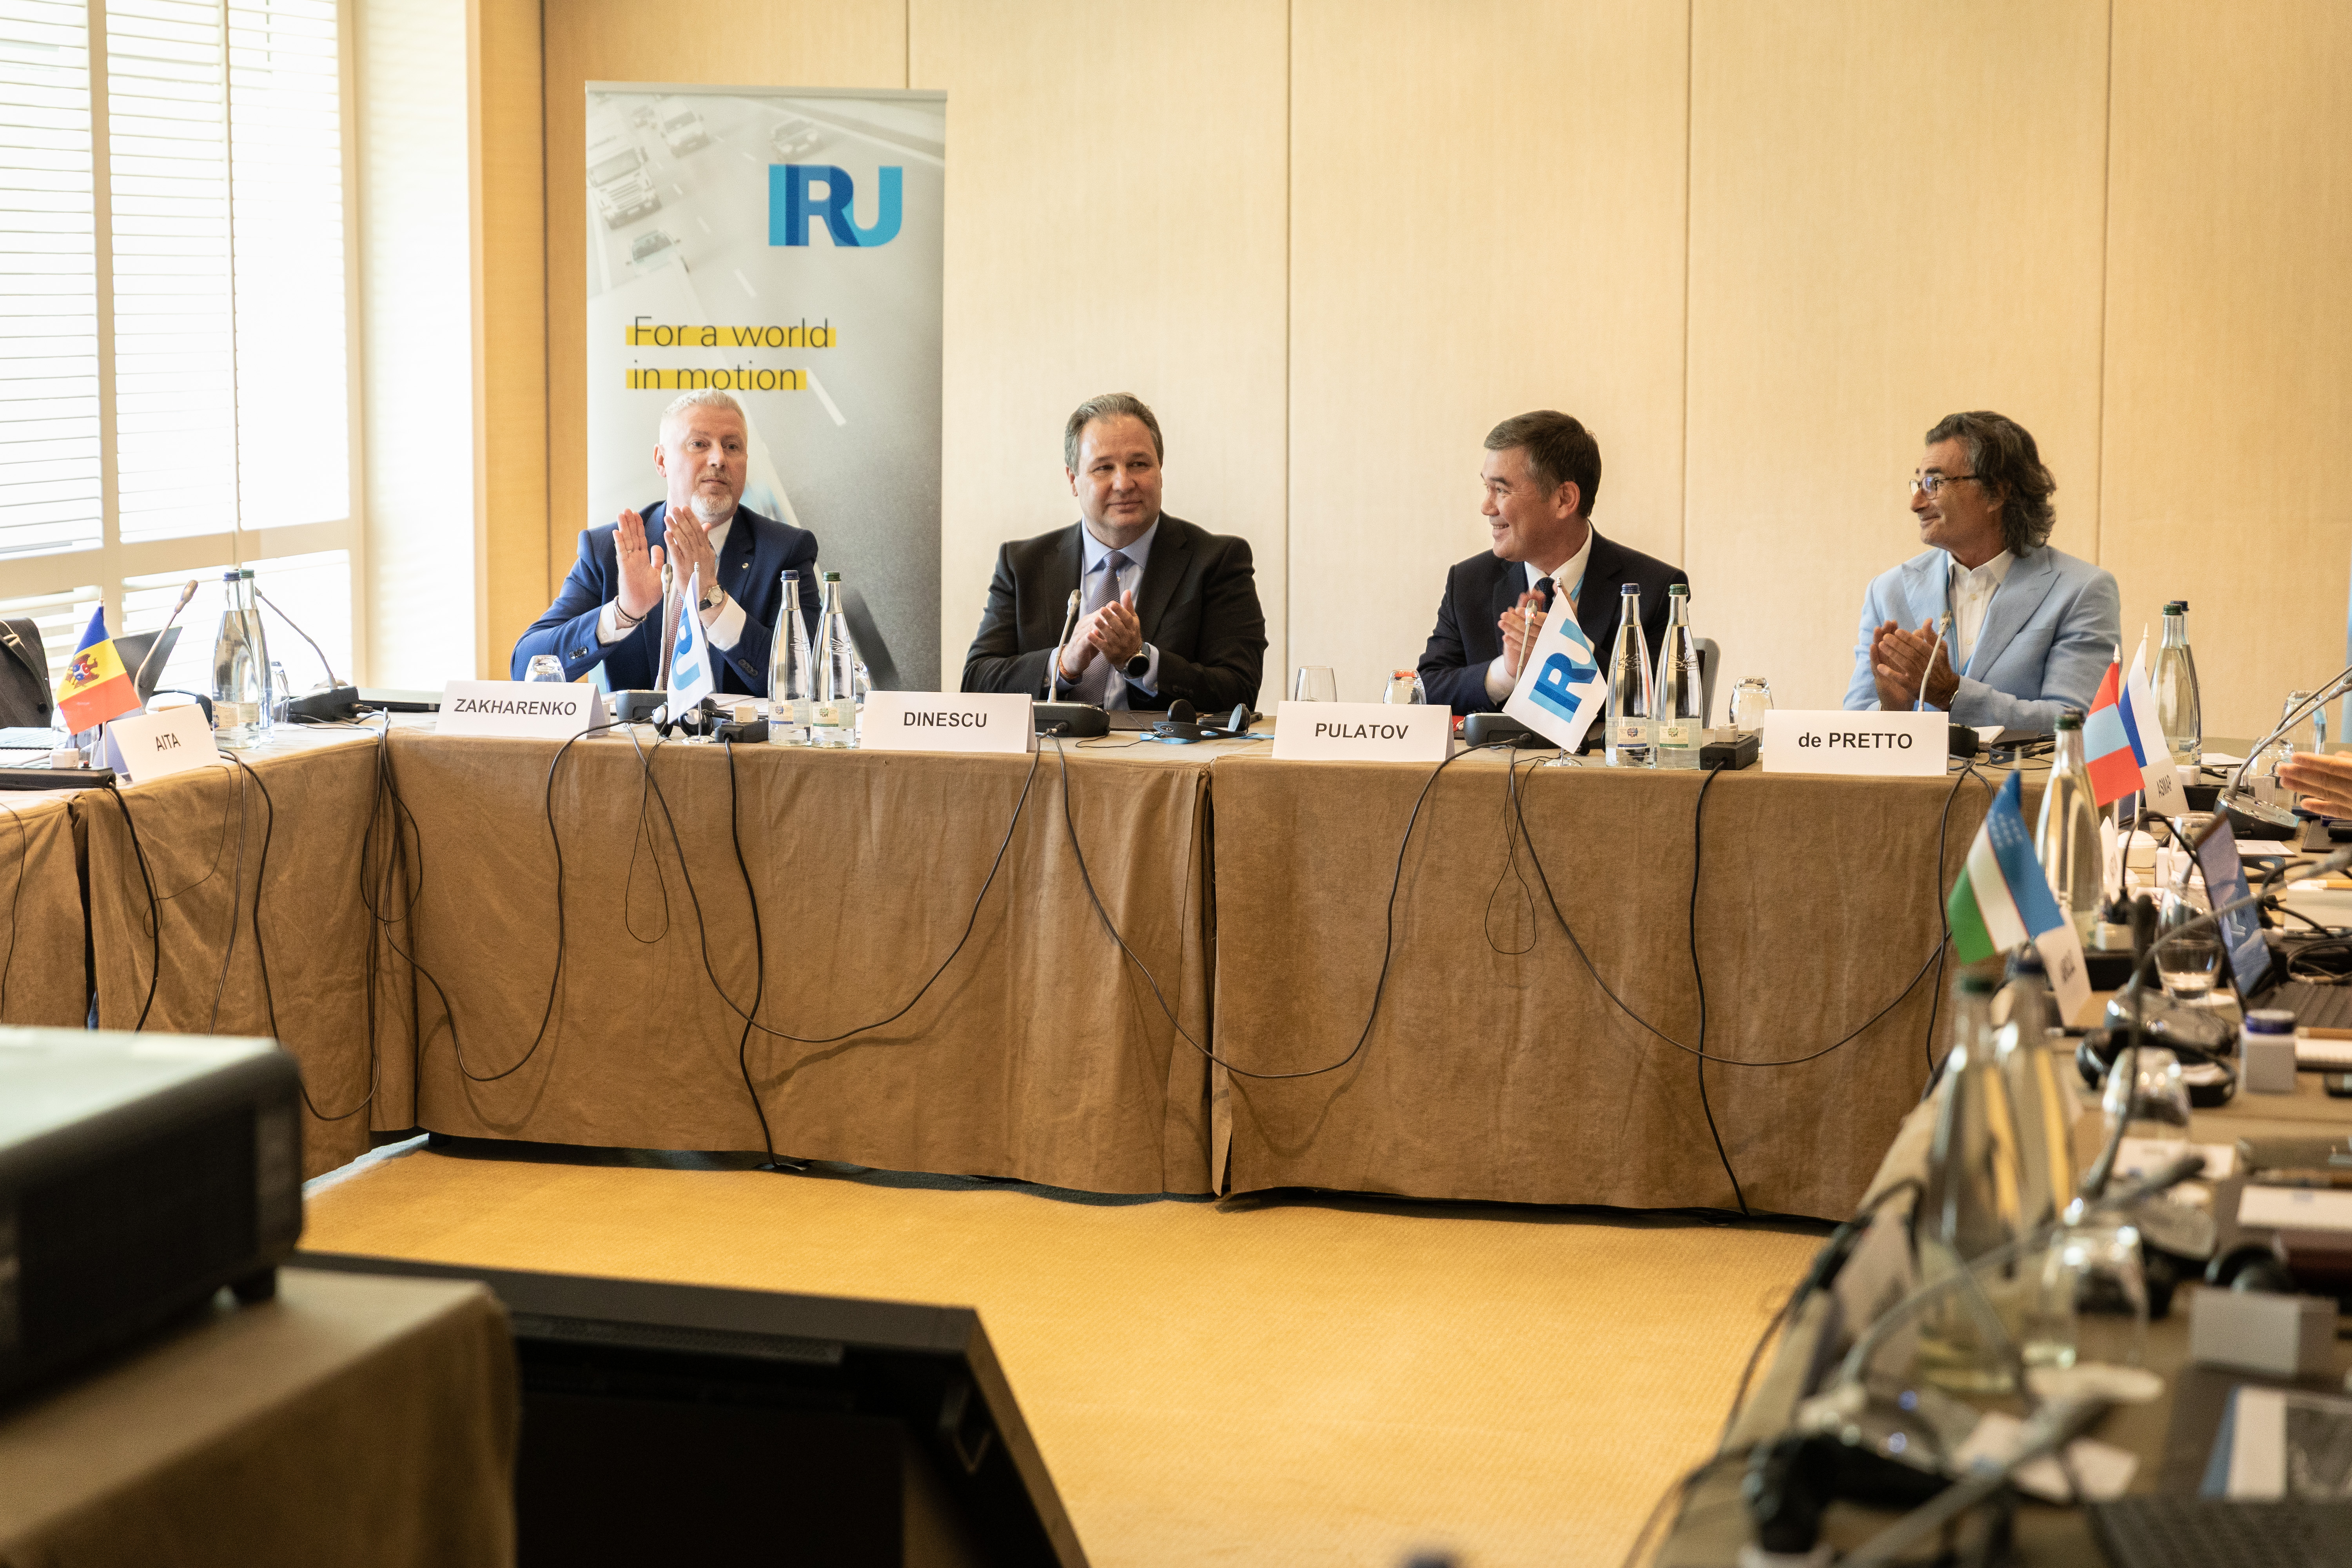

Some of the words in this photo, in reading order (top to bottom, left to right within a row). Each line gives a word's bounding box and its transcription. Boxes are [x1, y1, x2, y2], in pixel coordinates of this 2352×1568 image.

[769, 164, 902, 248] IRU
[635, 316, 688, 347] For
[701, 325, 717, 347] a
[731, 318, 828, 347] world
[634, 359, 661, 390] in
[677, 360, 797, 390] motion
[1528, 617, 1598, 724] IRU
[454, 699, 576, 715] ZAKHARENKO
[904, 711, 987, 728] DINESCU
[1315, 723, 1409, 739] PULATOV
[1798, 732, 1822, 748] de
[1829, 732, 1913, 749] PRETTO
[156, 733, 181, 752] AITA
[2156, 774, 2172, 798] ASMAP
